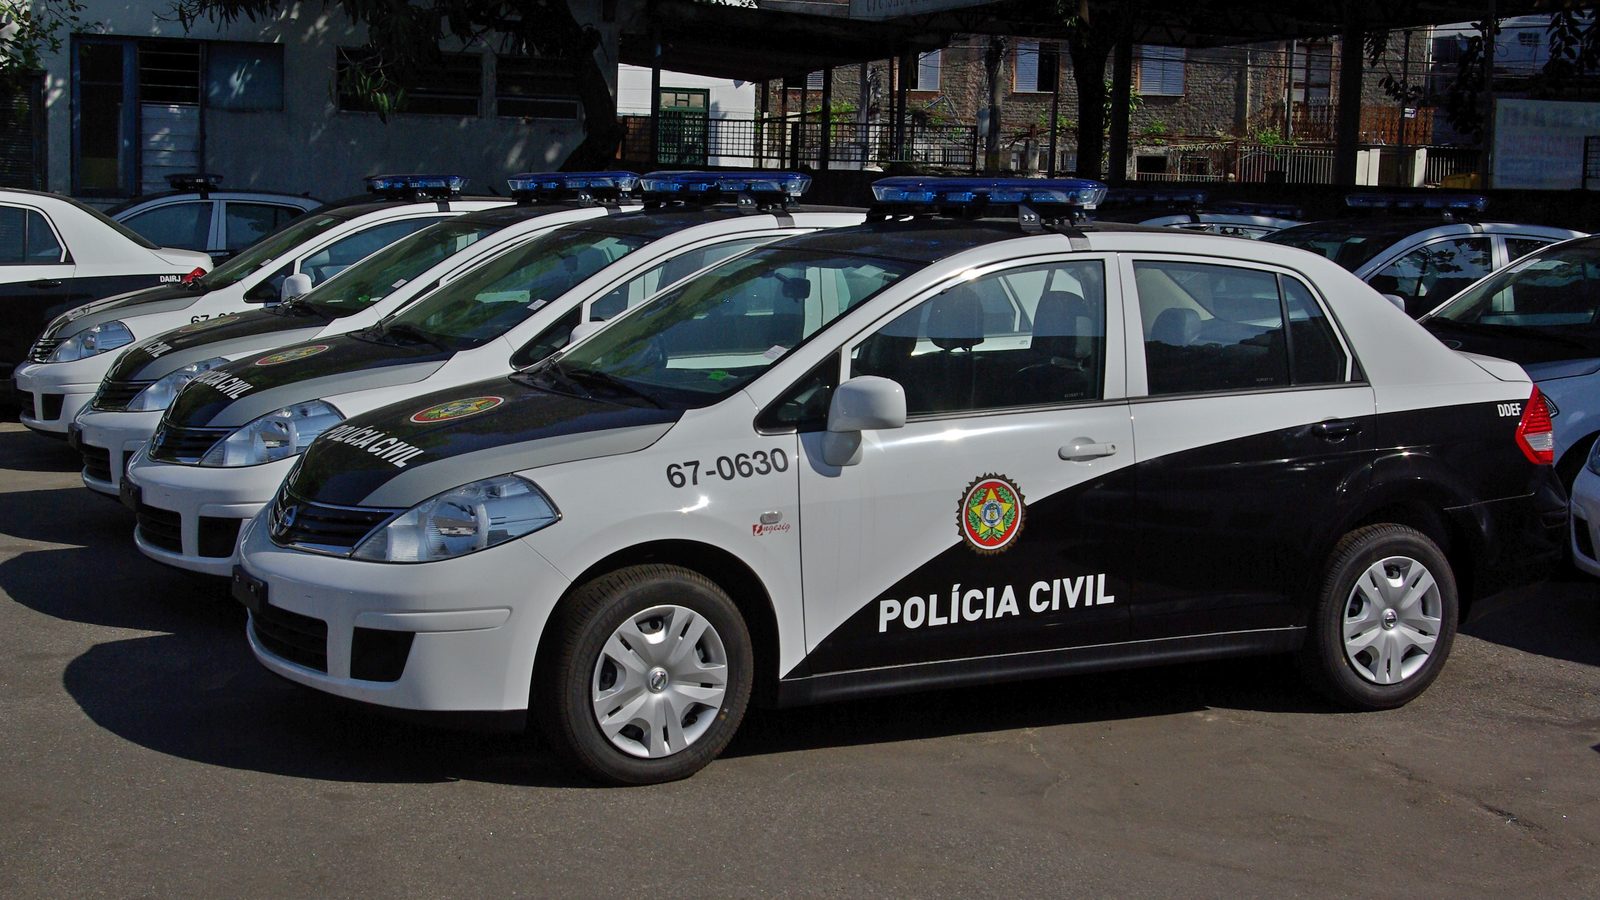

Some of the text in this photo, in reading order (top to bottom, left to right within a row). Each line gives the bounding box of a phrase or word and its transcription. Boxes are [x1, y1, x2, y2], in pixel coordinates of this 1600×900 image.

[160, 275, 181, 283] DAIRJ
[215, 377, 254, 399] CIVIL
[1497, 403, 1522, 417] DDEF
[367, 437, 425, 468] CIVIL
[666, 448, 788, 488] 67-0630
[879, 573, 1115, 632] POLÍCIA CIVIL
